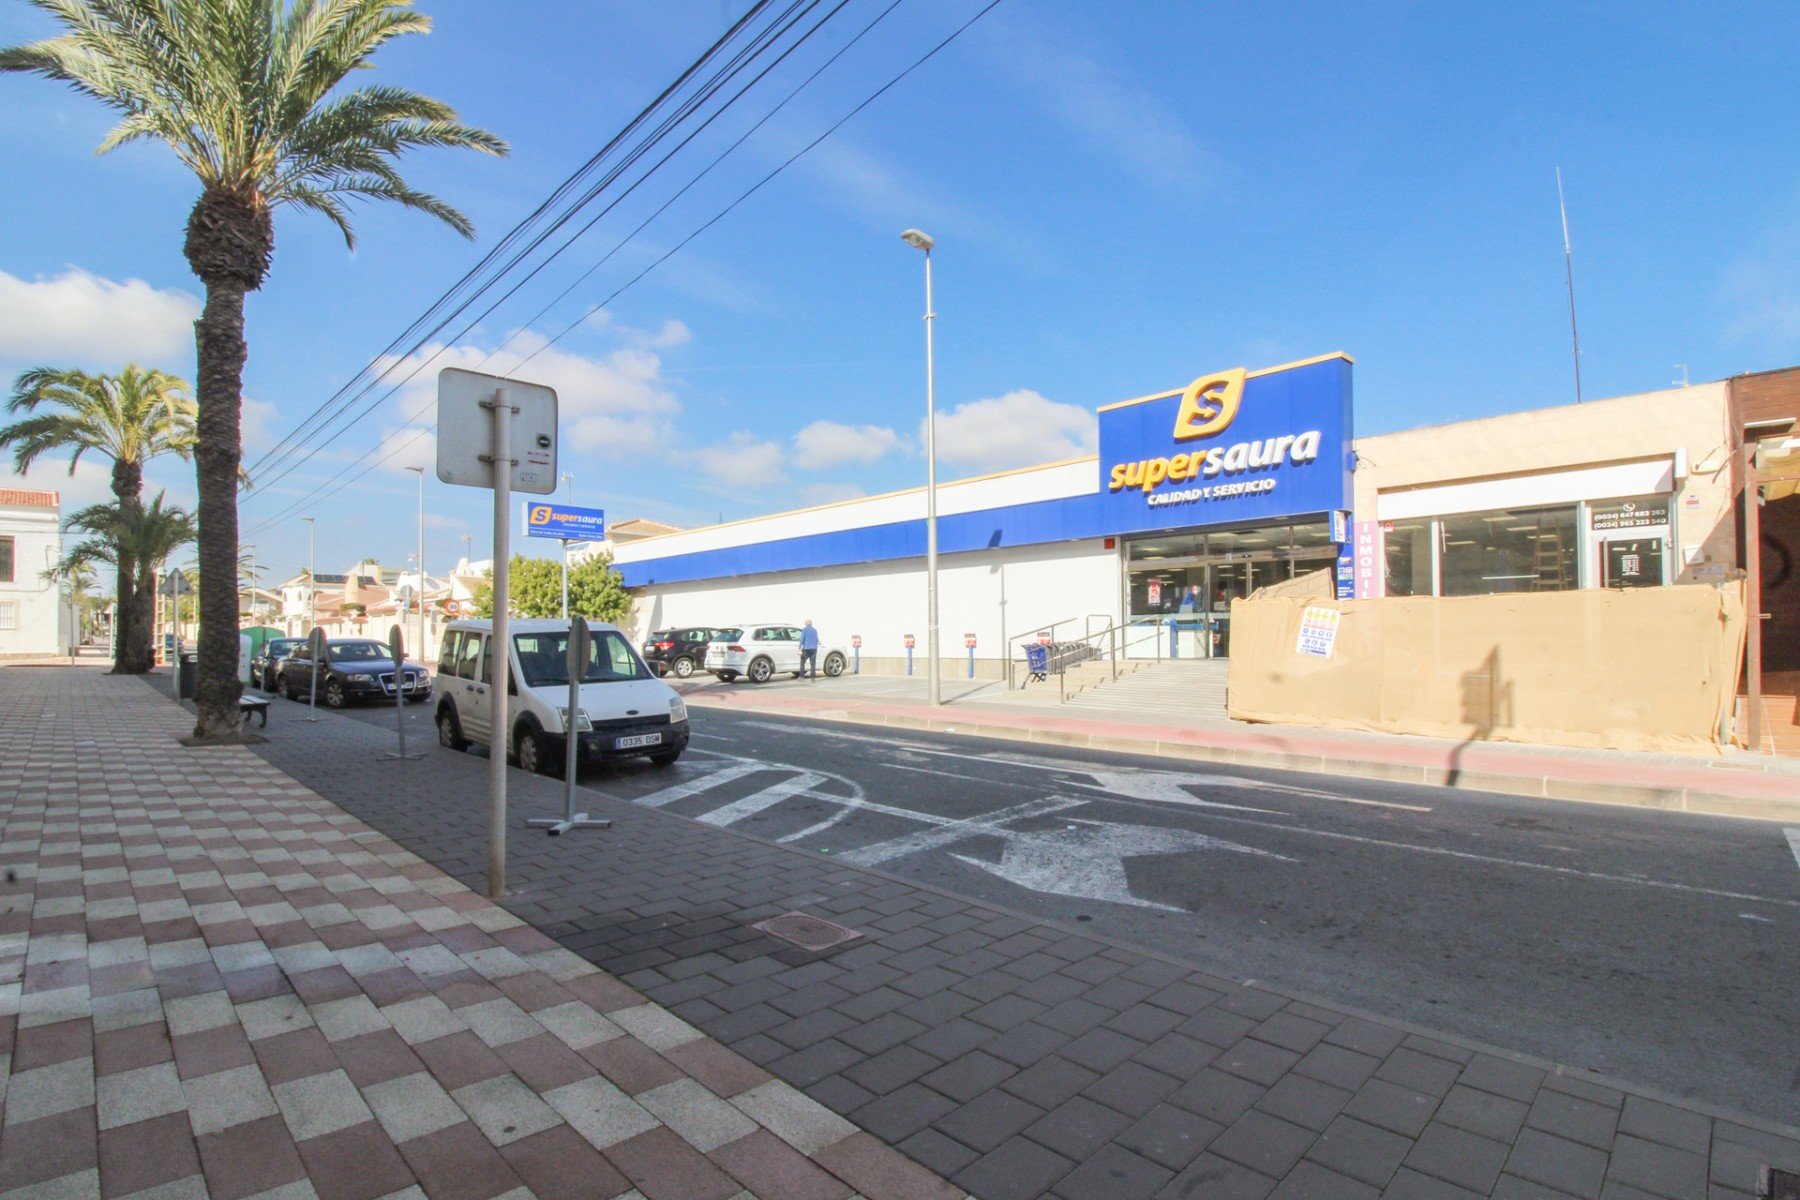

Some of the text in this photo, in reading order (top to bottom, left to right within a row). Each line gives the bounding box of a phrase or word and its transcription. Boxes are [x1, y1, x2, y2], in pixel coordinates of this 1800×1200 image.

[1108, 431, 1321, 492] supersaura
[1148, 479, 1276, 505] CALIDAD Y SERVICIO
[551, 513, 603, 525] supersaura
[1594, 512, 1618, 521] (0034)
[1594, 521, 1618, 530] (0034)
[1359, 523, 1373, 599] INMOBIL
[623, 737, 643, 746] 0335
